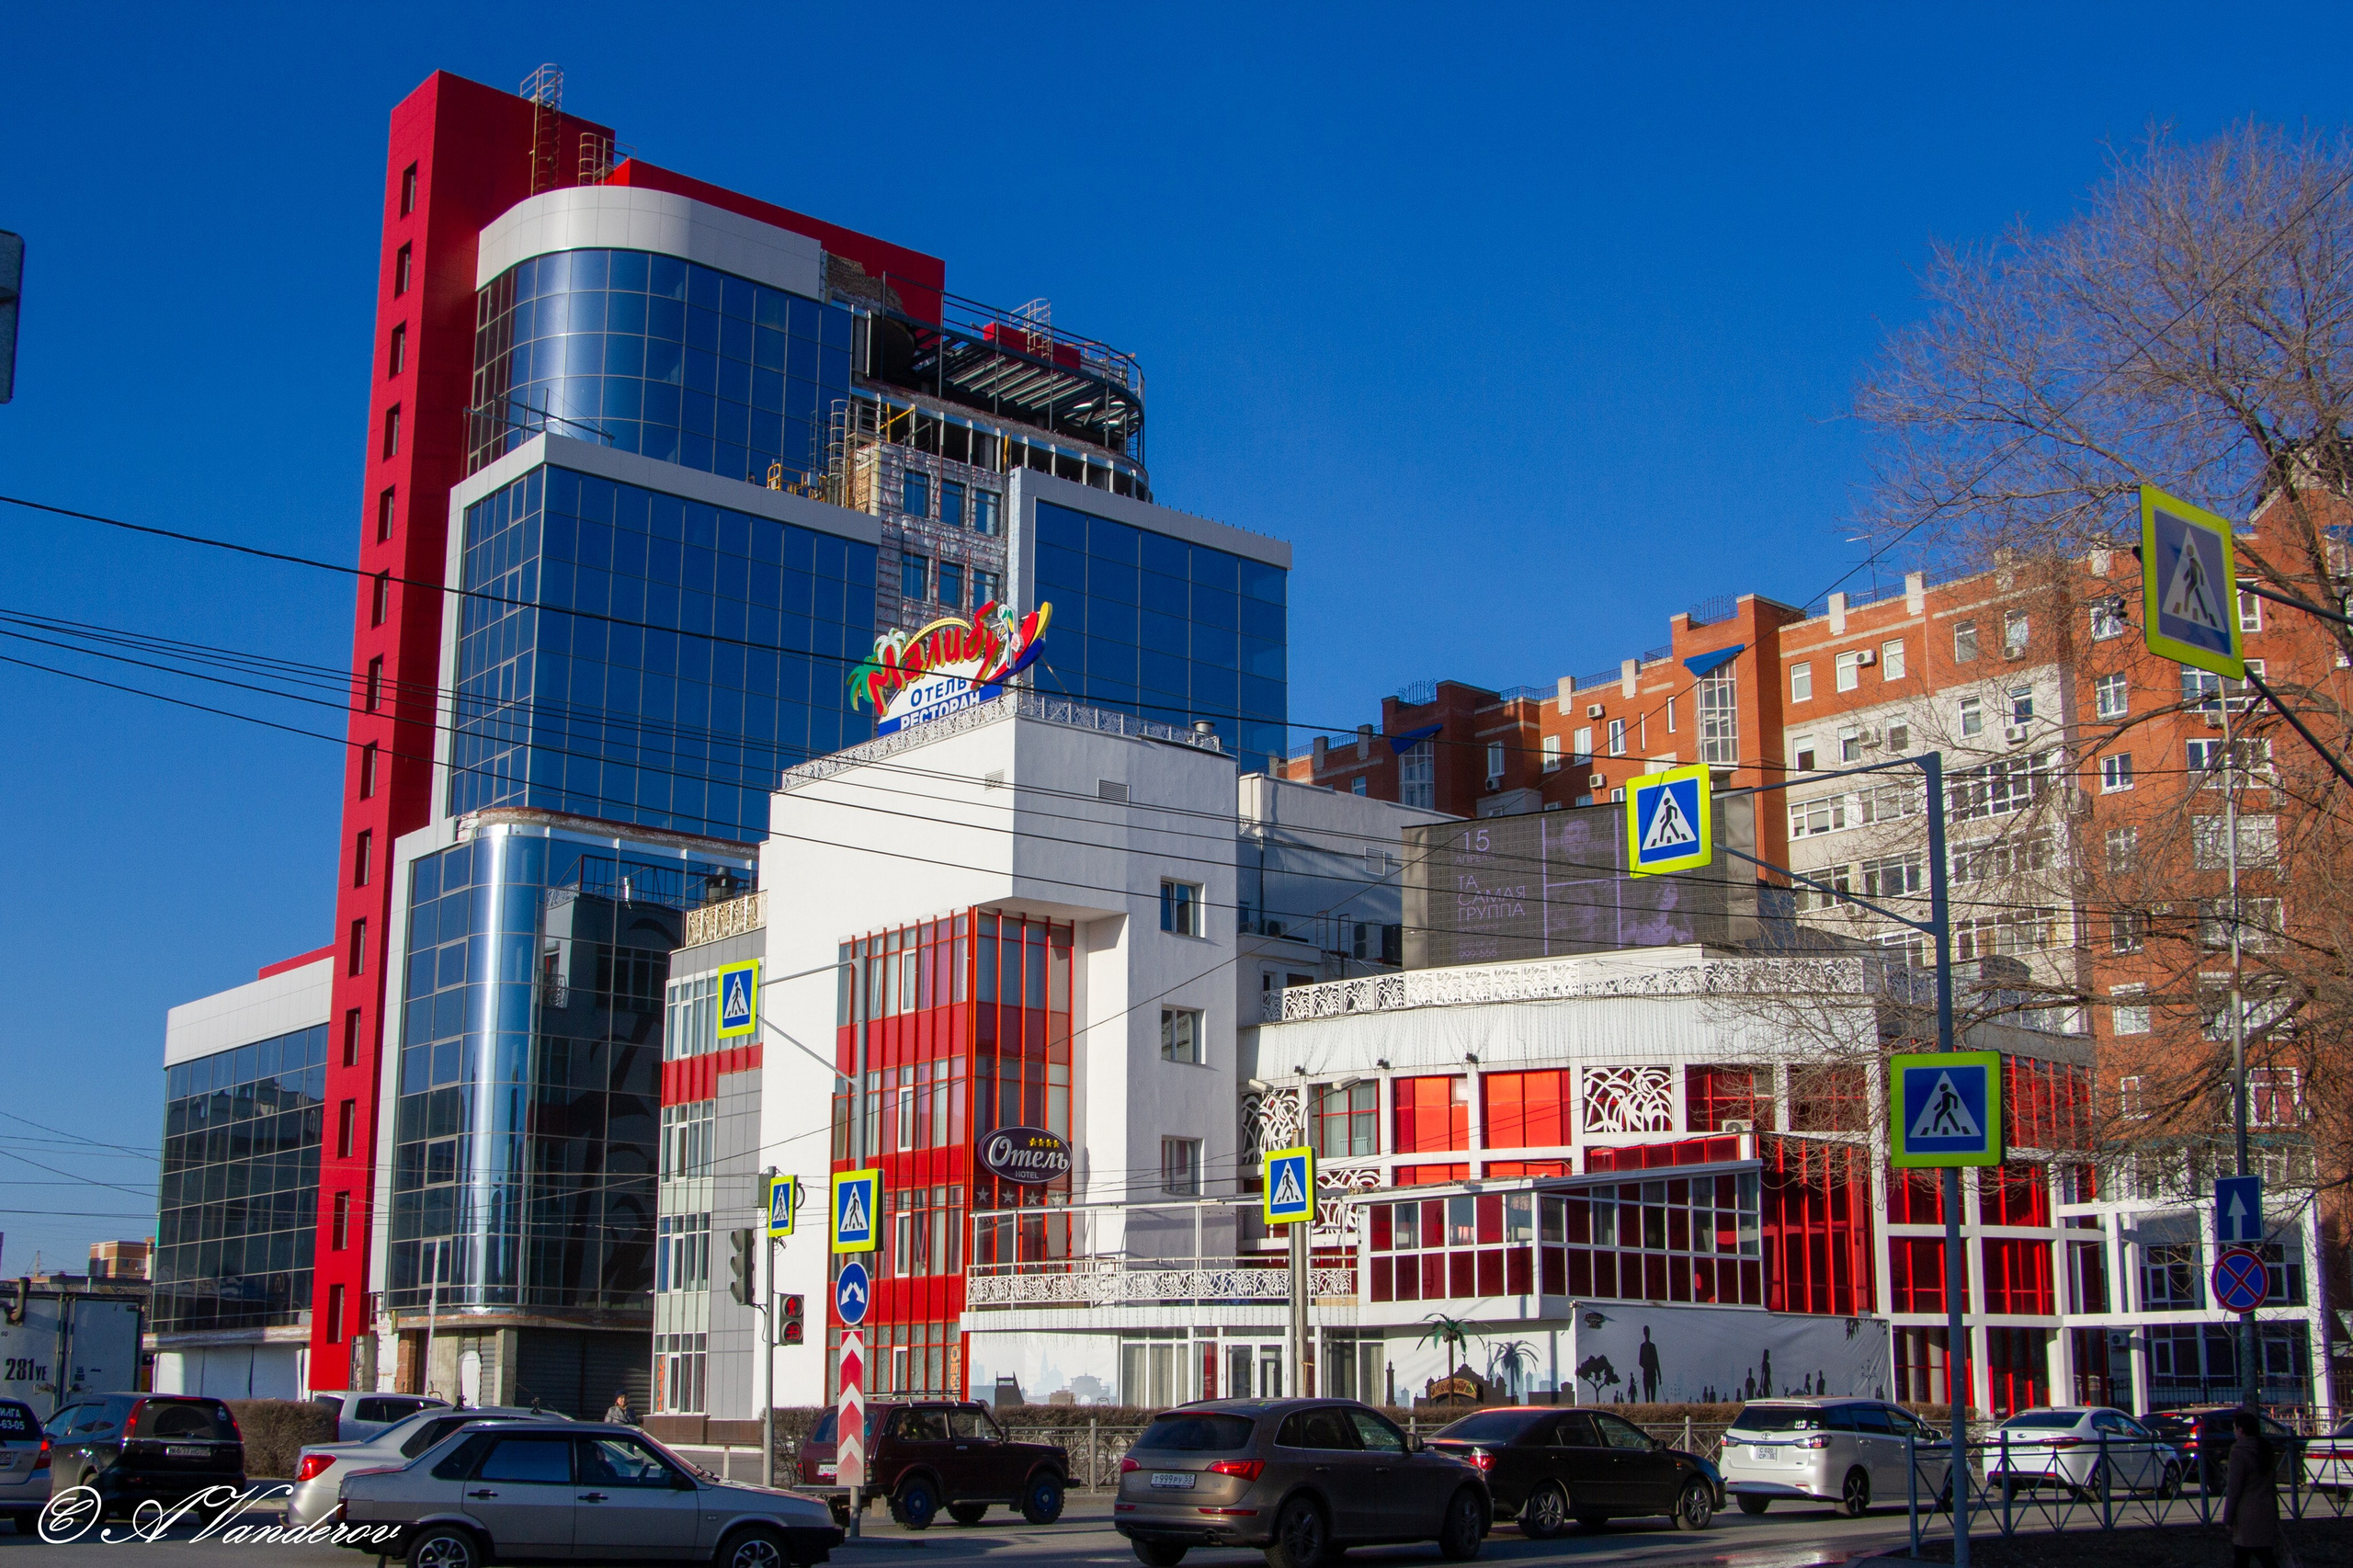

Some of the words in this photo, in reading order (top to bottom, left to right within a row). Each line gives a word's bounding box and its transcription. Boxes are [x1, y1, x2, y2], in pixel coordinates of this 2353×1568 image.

[868, 600, 1002, 716] Малибу
[911, 676, 967, 708] ОТЕЛЬ
[900, 691, 980, 729] РЕСТОРАН
[1463, 829, 1490, 853] 15
[1458, 875, 1478, 890] ТА
[1458, 886, 1526, 906] САМАЯ
[1458, 903, 1526, 922] ГРУППА
[988, 1136, 1069, 1169] Отель
[1016, 1170, 1039, 1179] HOTEL
